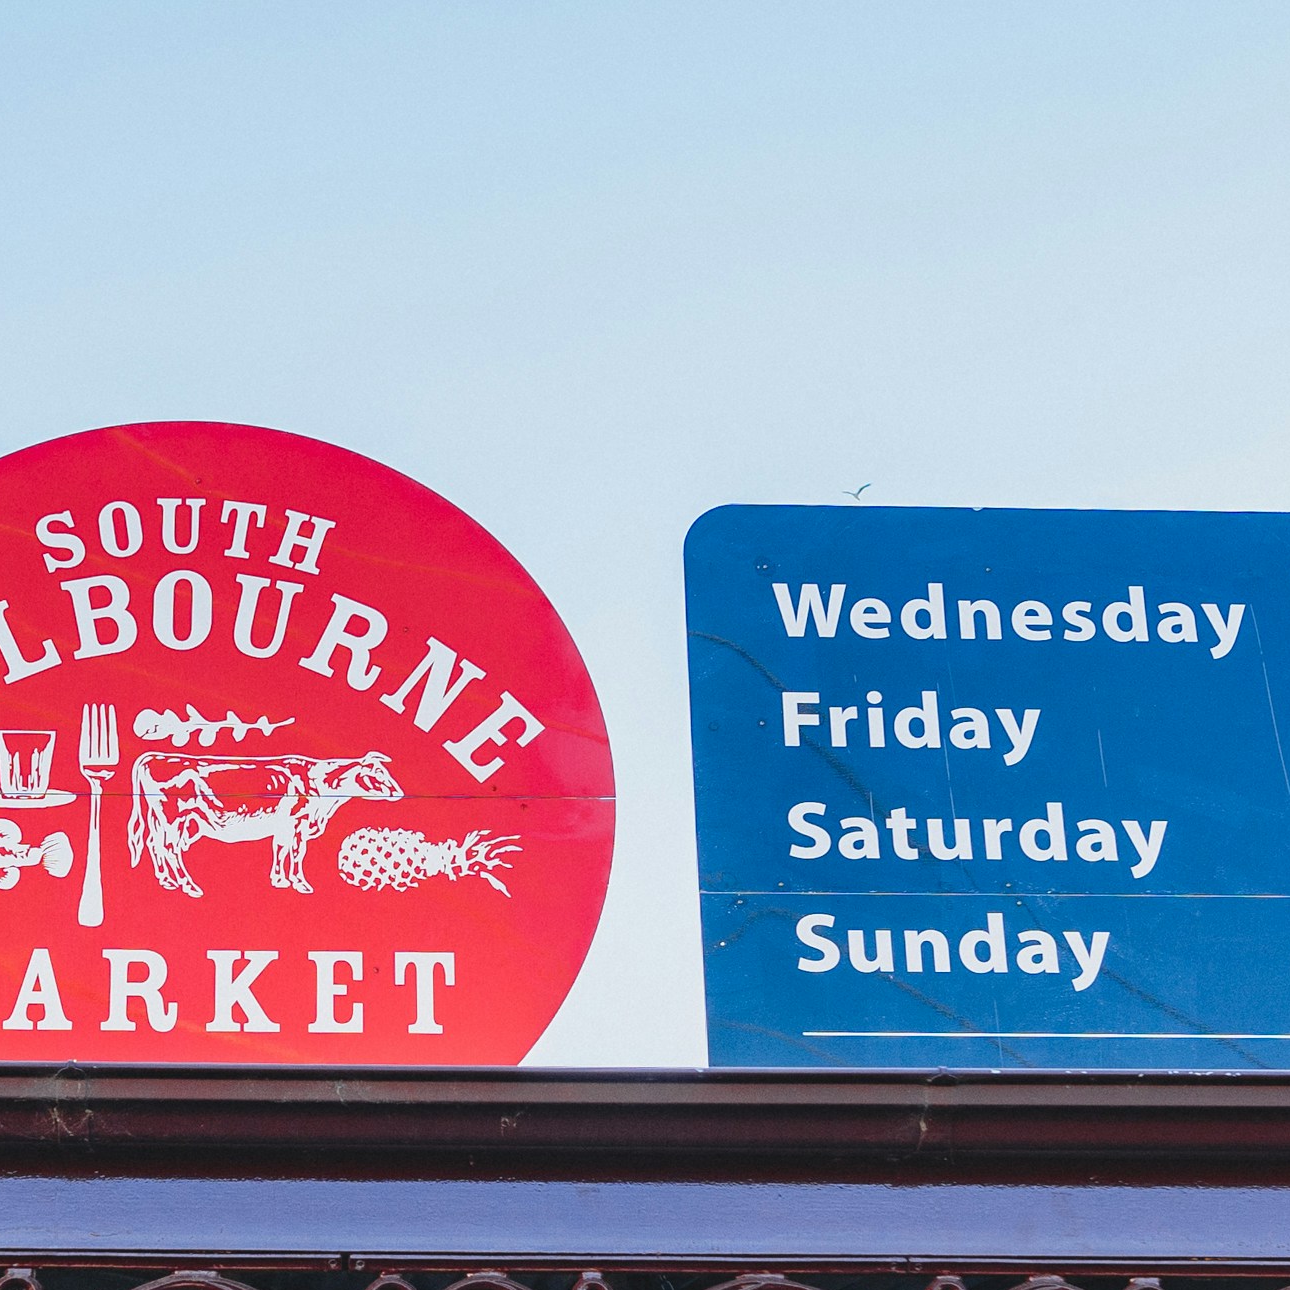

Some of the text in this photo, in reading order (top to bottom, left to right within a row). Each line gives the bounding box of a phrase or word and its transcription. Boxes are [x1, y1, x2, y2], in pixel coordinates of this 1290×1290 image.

[35, 497, 337, 575] SOUTH
[772, 582, 1247, 660] Wednesday
[782, 690, 1041, 767] Friday
[787, 801, 1169, 880] Saturday
[795, 912, 1111, 993] Sunday
